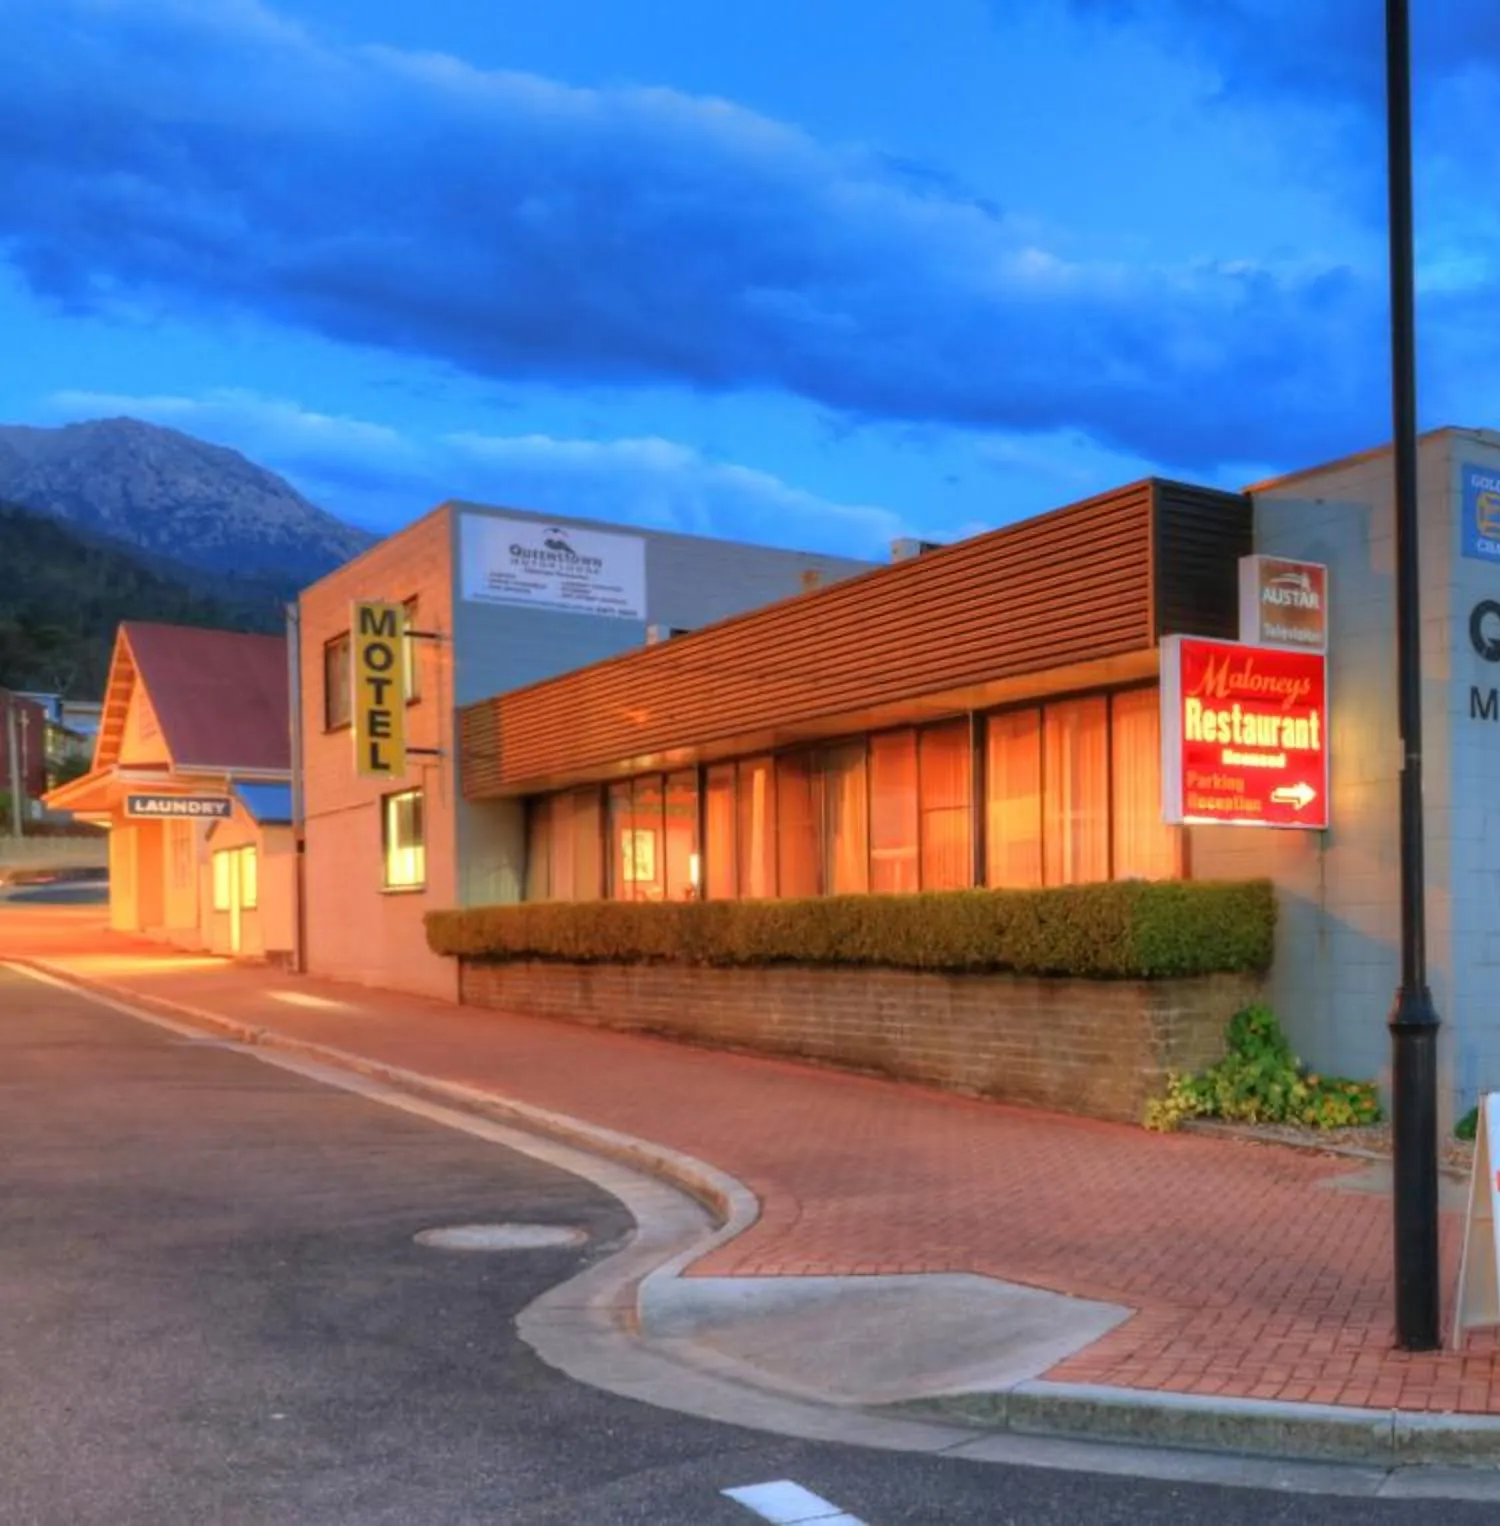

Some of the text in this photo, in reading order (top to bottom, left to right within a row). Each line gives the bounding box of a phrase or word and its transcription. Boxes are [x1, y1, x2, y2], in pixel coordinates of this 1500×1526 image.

[1263, 588, 1319, 609] AUSTAR
[360, 606, 397, 772] MOTEL
[1187, 653, 1311, 709] Maloneys
[1185, 697, 1320, 751] Restaurant
[1187, 772, 1245, 794] Parking
[134, 799, 226, 815] LAUNDRY
